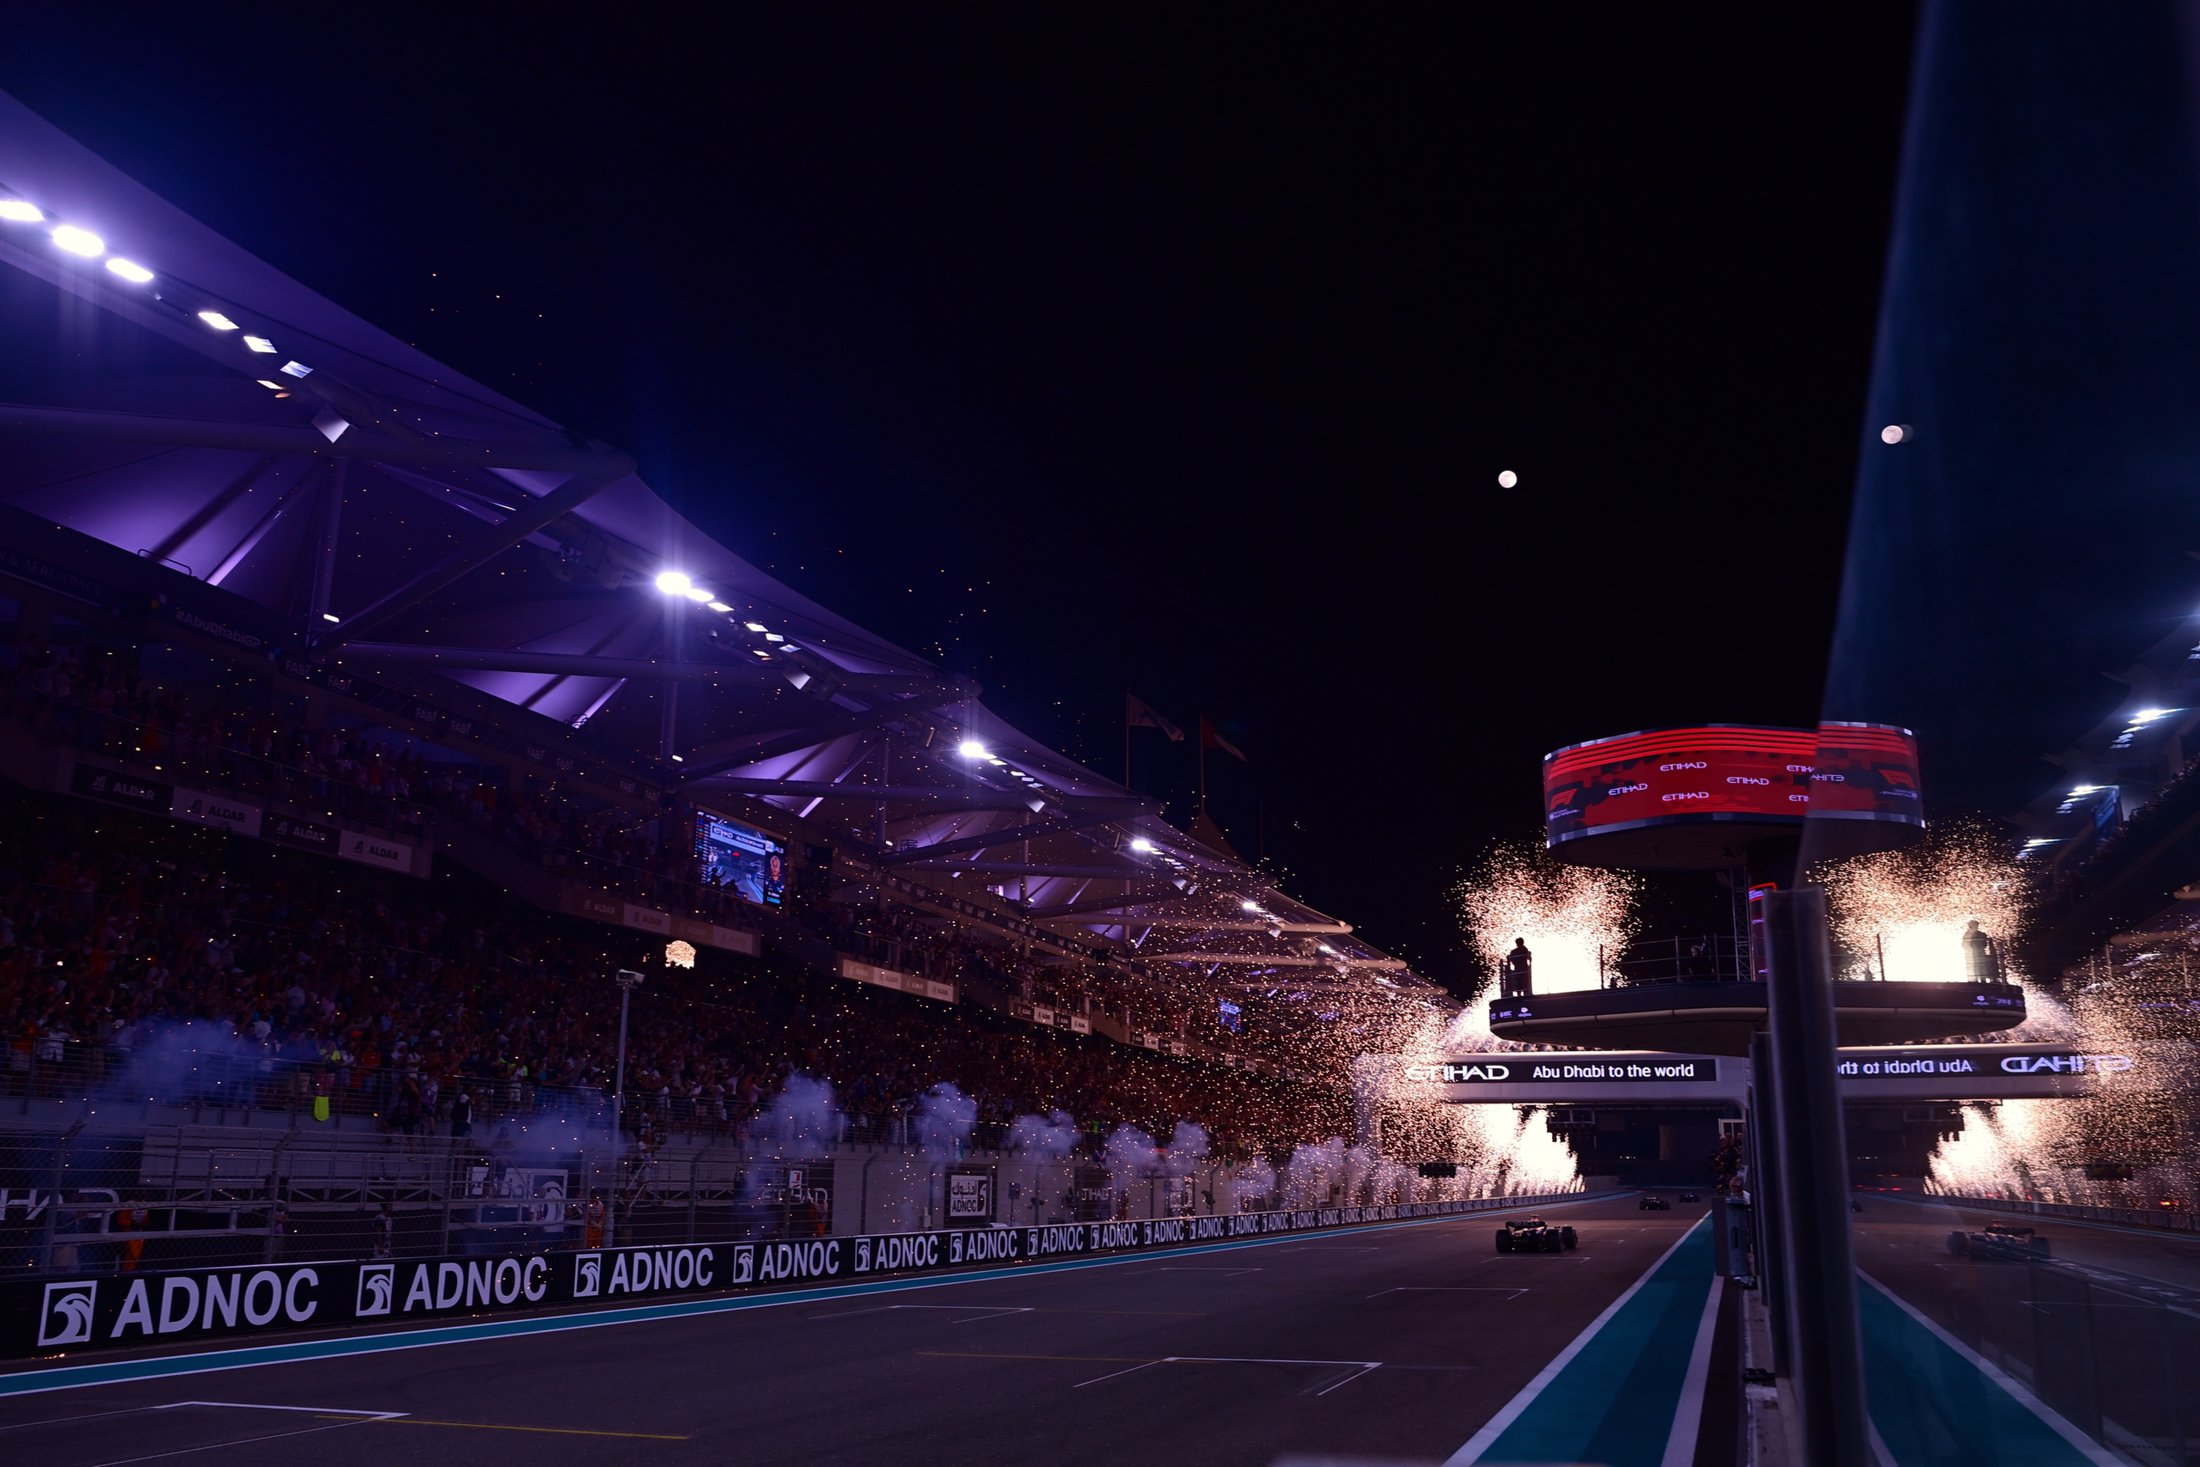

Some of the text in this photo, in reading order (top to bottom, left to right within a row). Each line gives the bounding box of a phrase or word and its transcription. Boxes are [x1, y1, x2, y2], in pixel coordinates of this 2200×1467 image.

[175, 609, 261, 648] #AbuDhabiGP
[1659, 762, 1707, 772] ETIHAD
[113, 781, 155, 801] ALDAR
[1608, 783, 1648, 796] ETIHAD
[1726, 776, 1770, 786] ETIHAD
[1661, 791, 1710, 801] ETIHAD
[209, 804, 246, 823] ALDAR
[292, 826, 326, 843] ALDAR
[368, 845, 399, 861] ALDAR
[1532, 1065, 1560, 1078] Abu
[1564, 1065, 1605, 1078] Dhabi
[1608, 1065, 1624, 1078] to
[1627, 1064, 1651, 1077] the
[1654, 1064, 1694, 1077] world
[952, 1199, 977, 1212] ADNOC
[1198, 1217, 1224, 1239] ADNOC
[1235, 1215, 1259, 1234] ADNOC
[1268, 1212, 1289, 1231] ADNOC
[1041, 1226, 1084, 1256] ADNOC
[1101, 1223, 1138, 1249] ADNOC
[1154, 1220, 1185, 1244] ADNOC
[875, 1235, 939, 1269] ADNOC
[966, 1231, 1018, 1261] ADNOC
[608, 1247, 714, 1293] ADNOC
[759, 1240, 840, 1280] ADNOC
[404, 1256, 547, 1312] ADNOC
[110, 1268, 319, 1338] ADNOC
